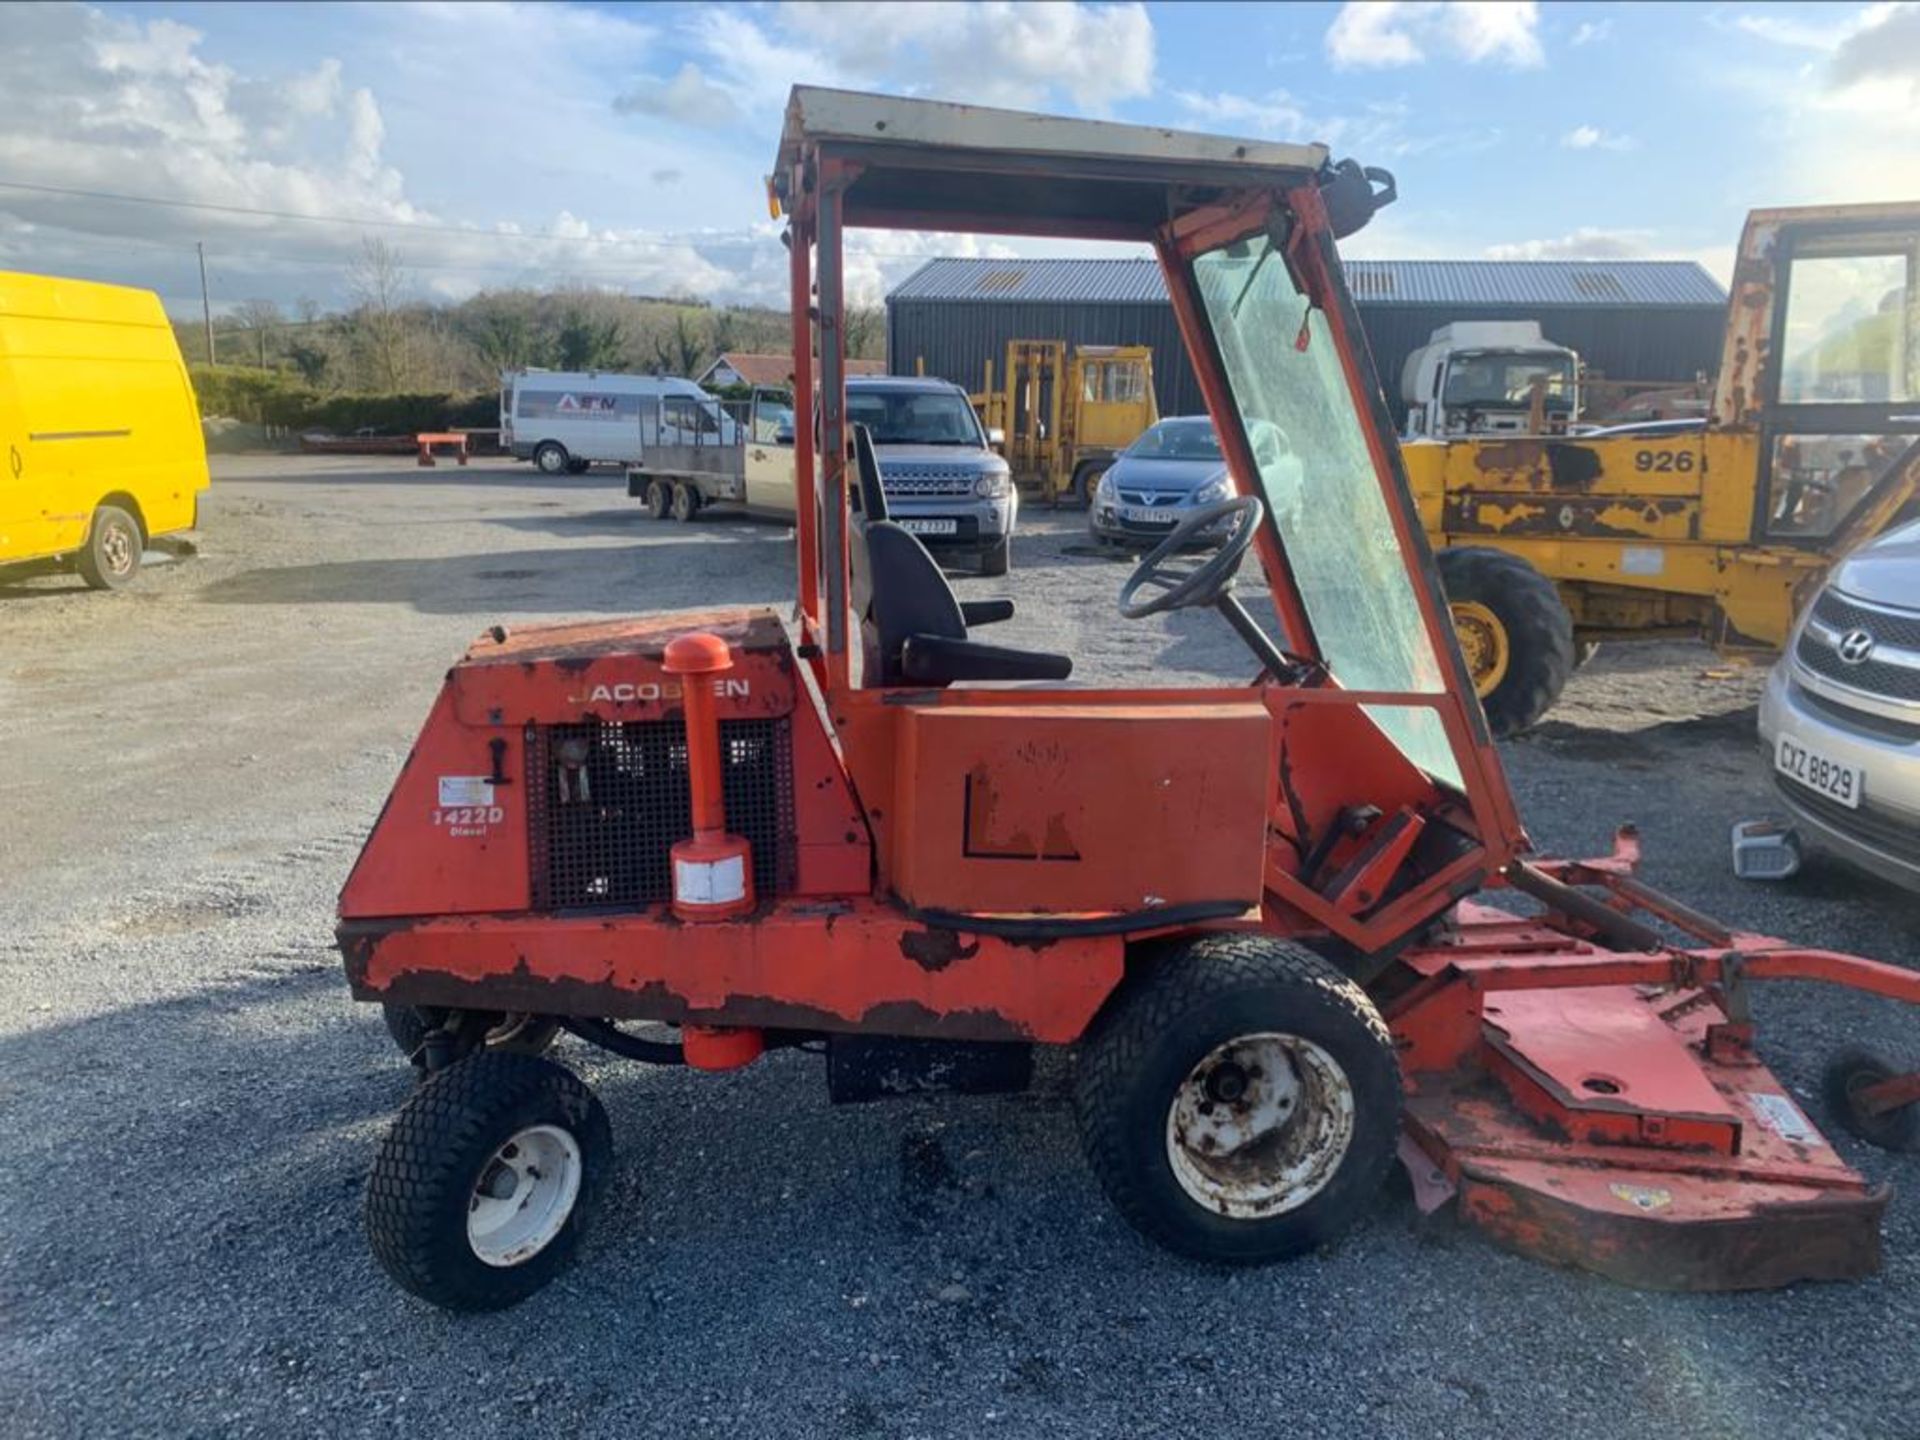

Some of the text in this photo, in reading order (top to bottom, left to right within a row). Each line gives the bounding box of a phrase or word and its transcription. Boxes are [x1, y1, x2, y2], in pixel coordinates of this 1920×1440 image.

[1634, 449, 1694, 472] 926
[568, 679, 749, 703] JACOBEN
[1781, 741, 1852, 799] CXZ 8829
[433, 807, 504, 826] 1422D
